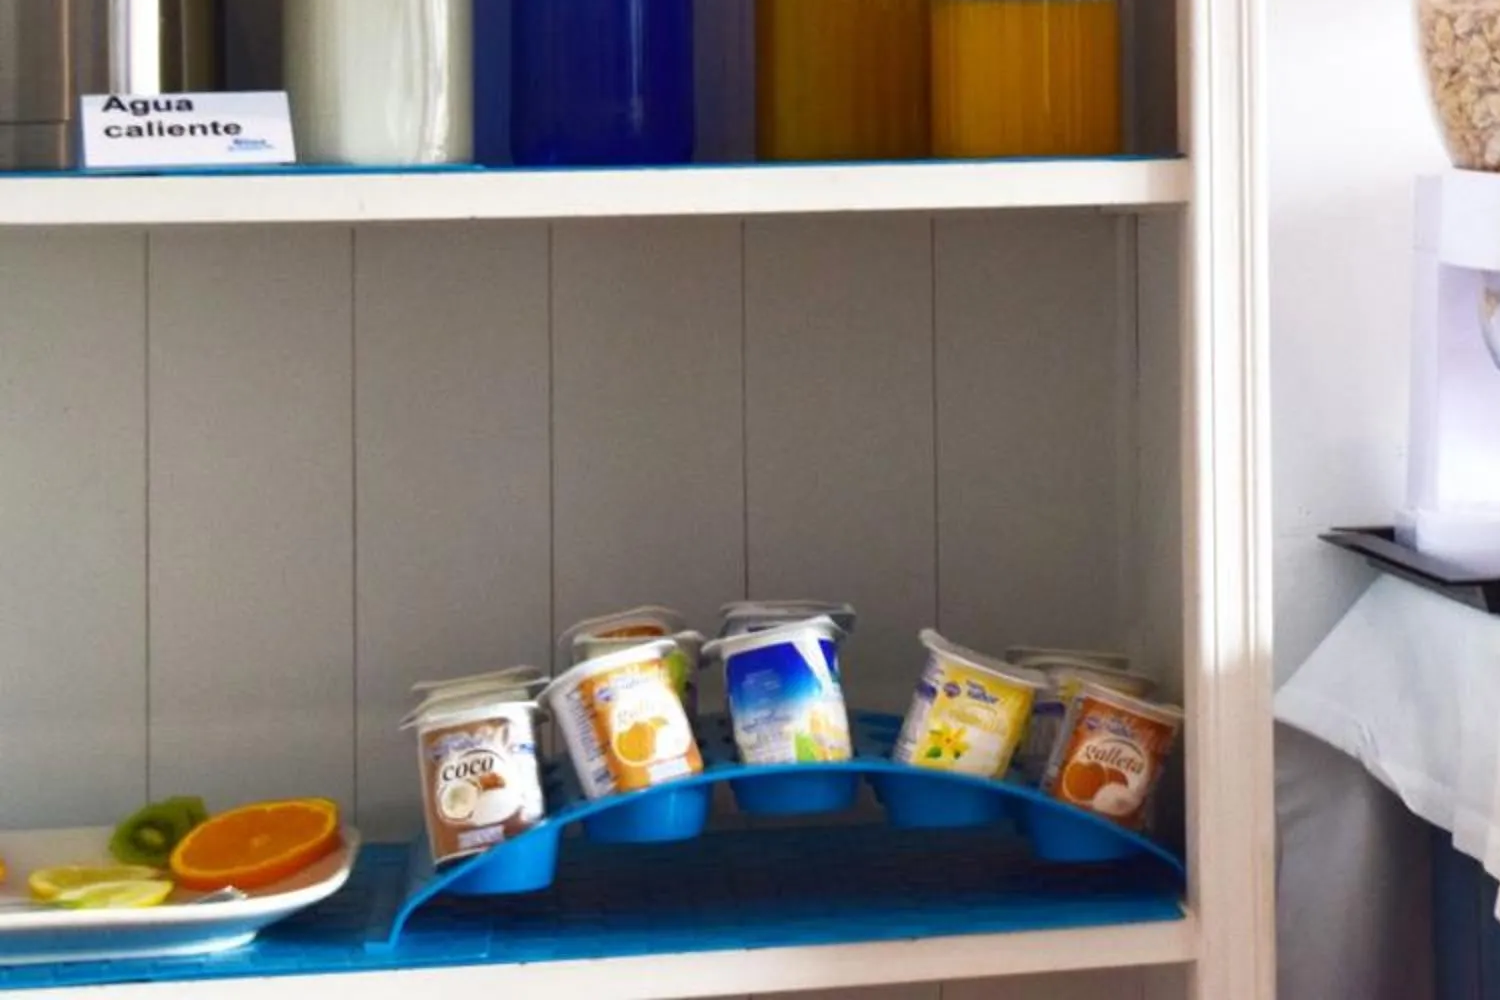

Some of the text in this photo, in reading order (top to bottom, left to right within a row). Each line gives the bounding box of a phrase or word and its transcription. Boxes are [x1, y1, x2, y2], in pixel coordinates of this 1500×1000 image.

[102, 95, 194, 117] Agua
[104, 120, 242, 138] caliente
[442, 757, 494, 782] coco
